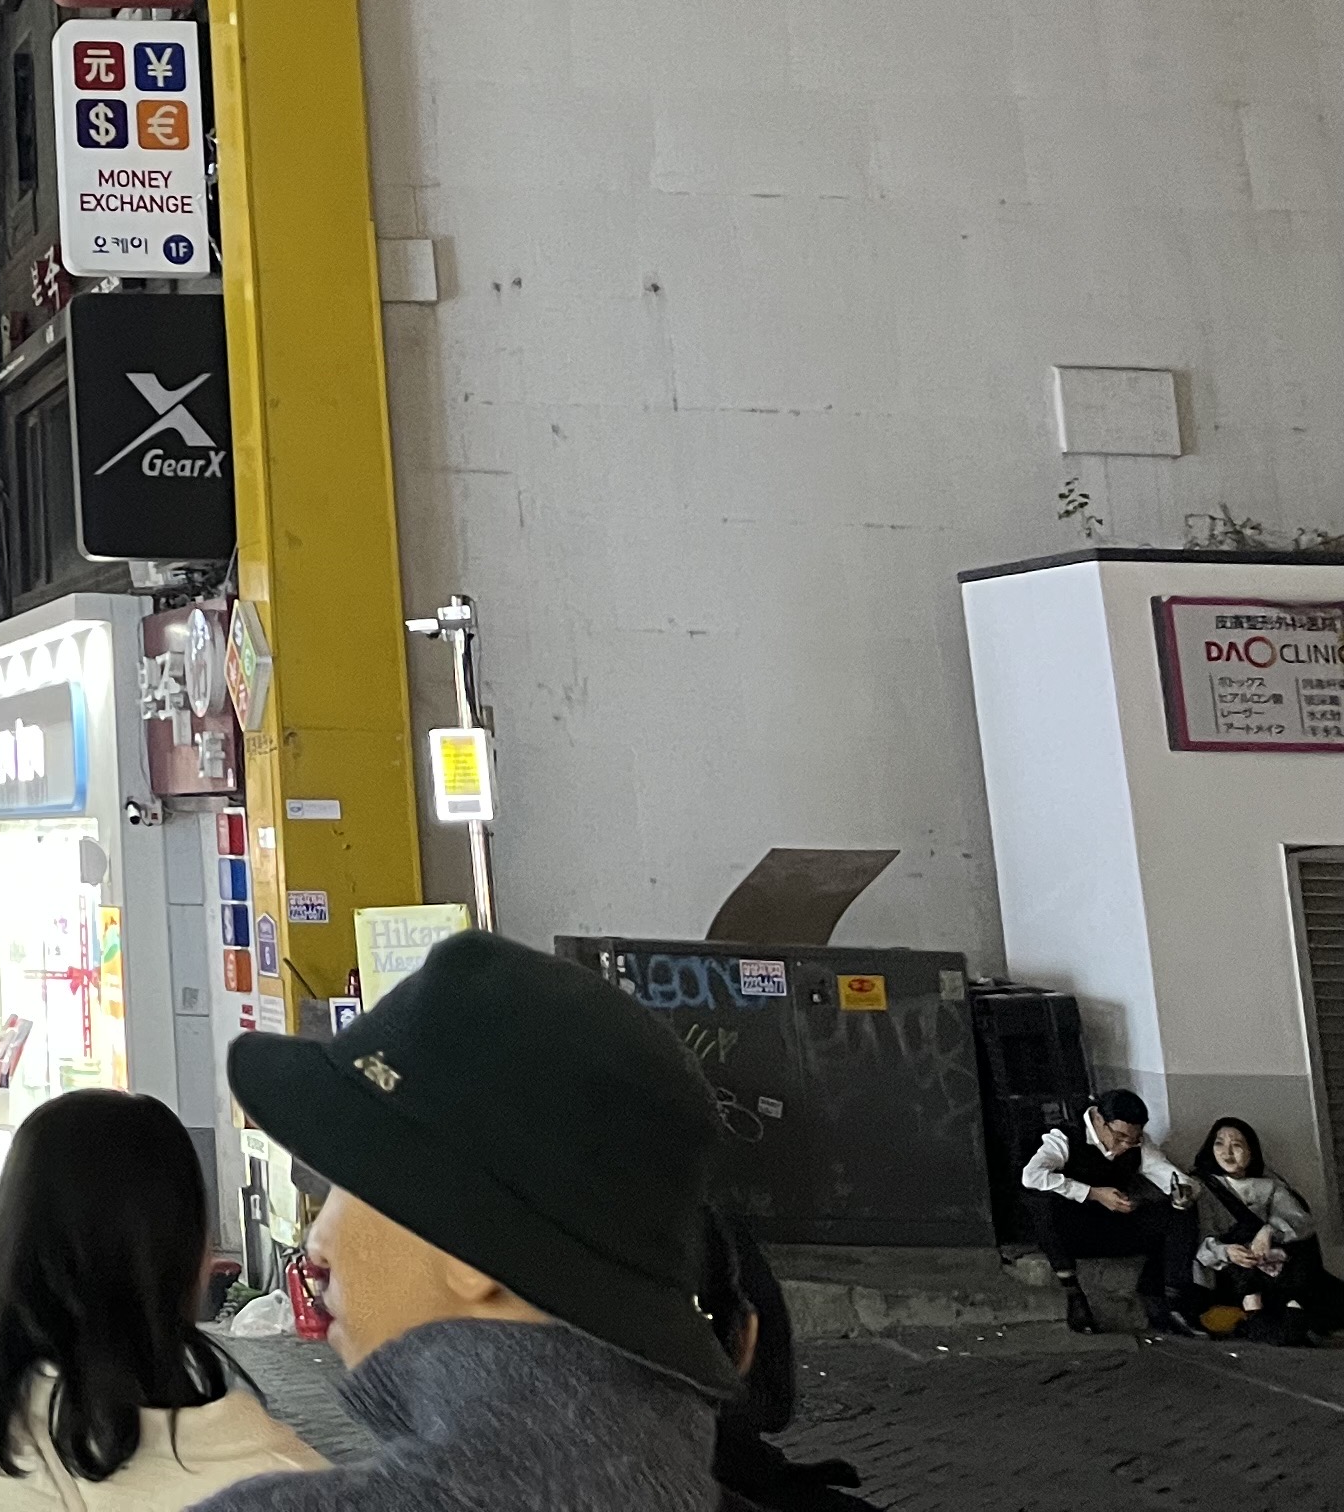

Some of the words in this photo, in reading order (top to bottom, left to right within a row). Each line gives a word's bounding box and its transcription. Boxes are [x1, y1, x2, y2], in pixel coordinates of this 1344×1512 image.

[83, 48, 115, 83] 元
[88, 102, 117, 146] $
[146, 104, 180, 146] €
[97, 168, 173, 189] MONEY
[79, 193, 194, 214] EXCHANGE
[92, 235, 149, 254] 오케이
[169, 242, 188, 257] 1F
[141, 448, 227, 478] GearX
